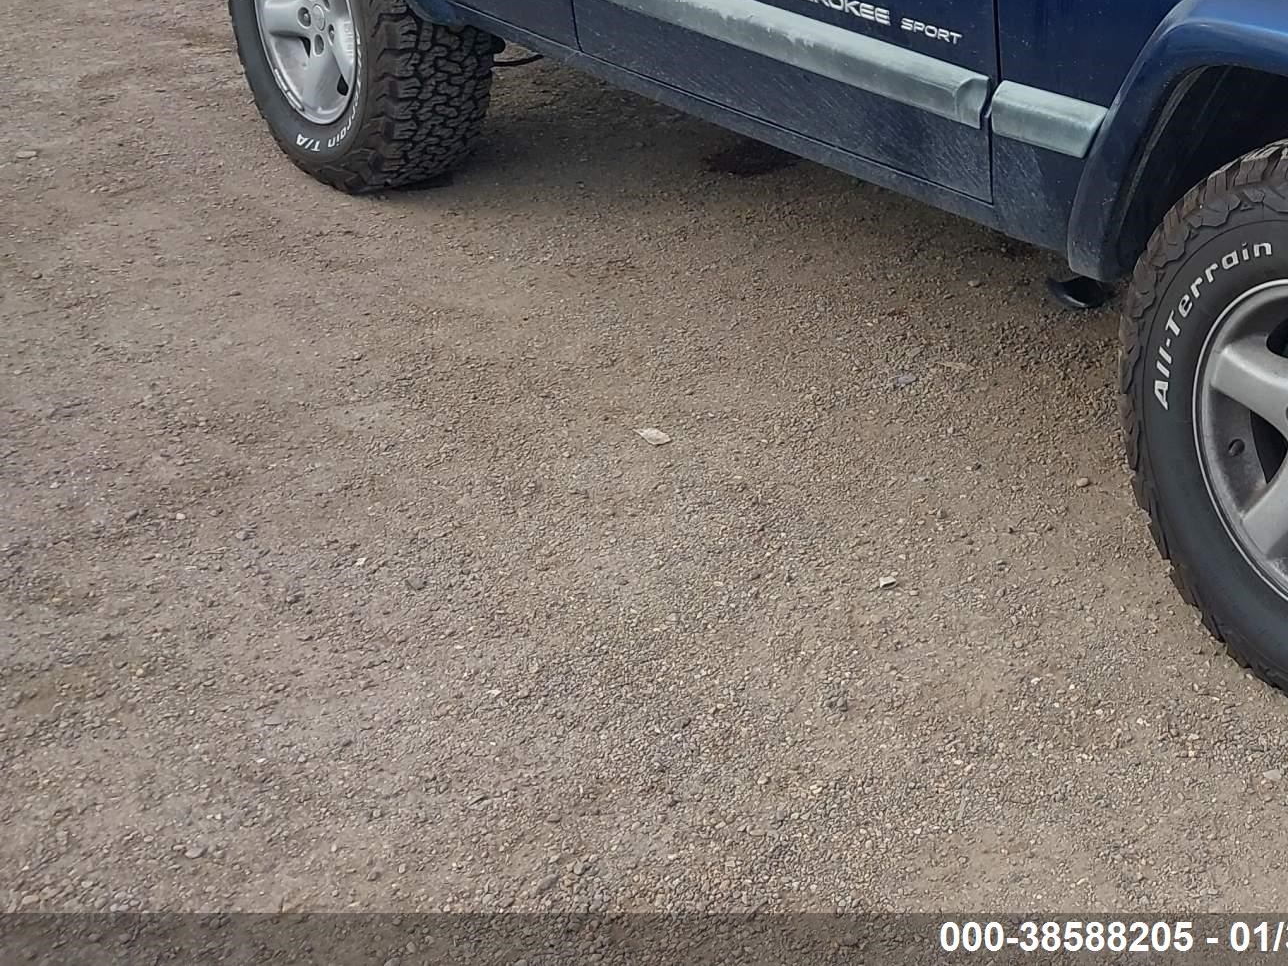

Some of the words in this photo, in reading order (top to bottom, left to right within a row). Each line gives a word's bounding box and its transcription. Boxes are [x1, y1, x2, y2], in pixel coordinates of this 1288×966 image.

[900, 17, 963, 45] SPORT
[296, 133, 321, 152] T/A
[1153, 242, 1273, 411] All-Terrain
